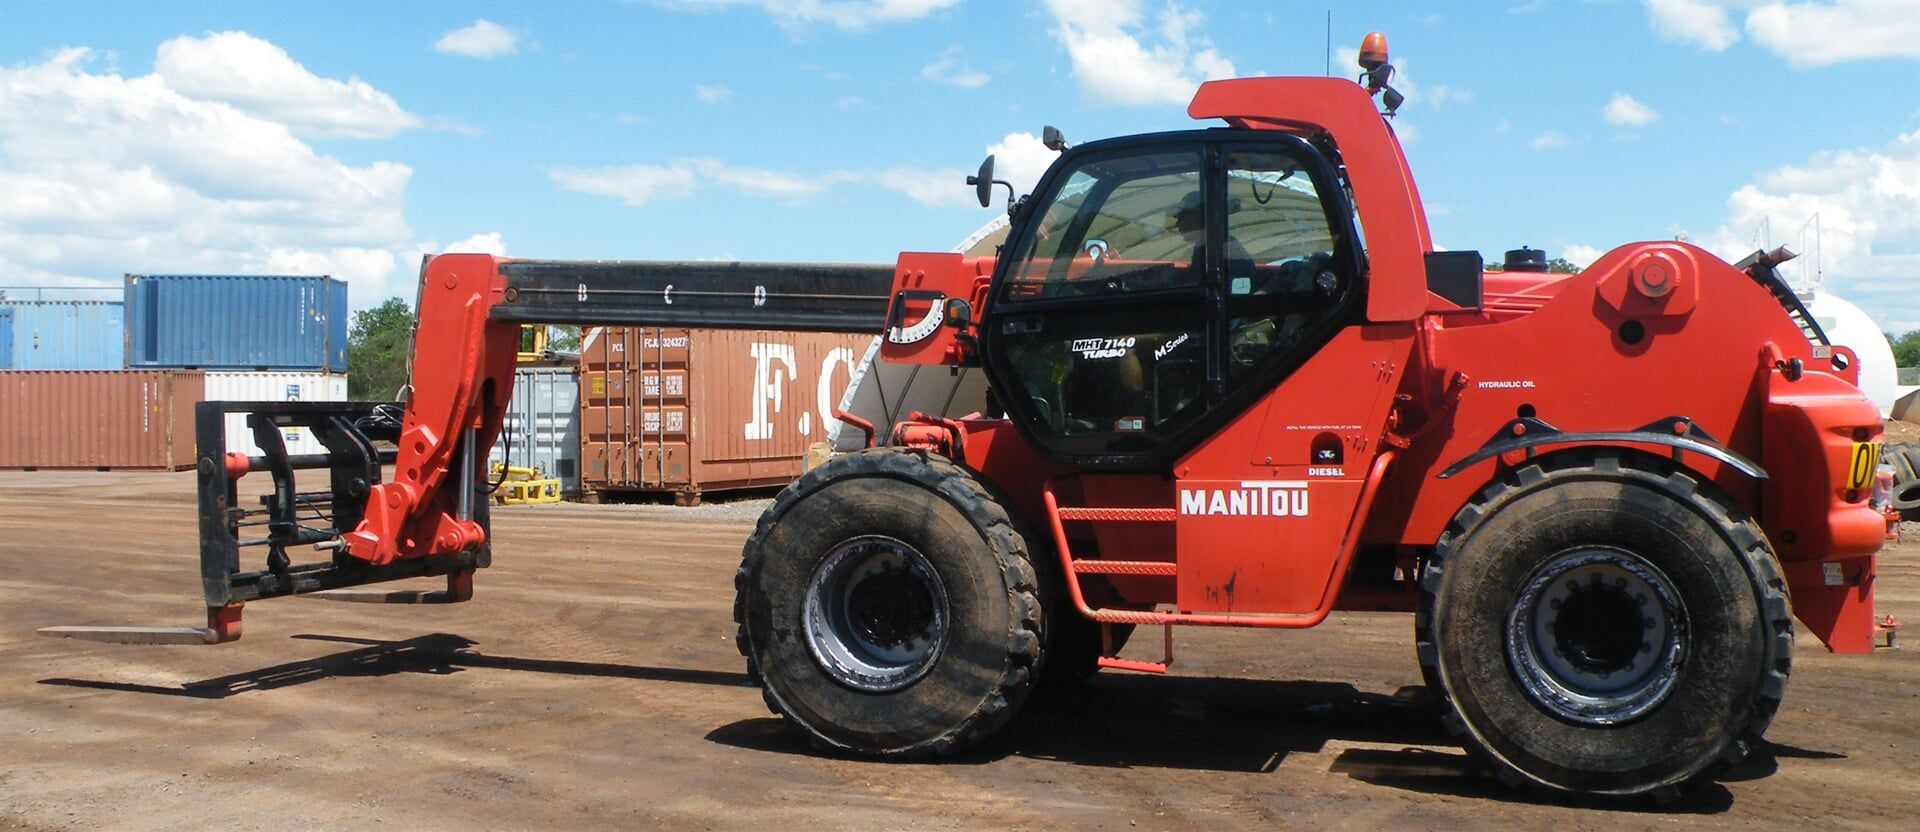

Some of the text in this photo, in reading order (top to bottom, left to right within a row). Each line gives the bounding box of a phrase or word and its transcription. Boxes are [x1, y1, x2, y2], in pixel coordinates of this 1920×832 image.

[664, 284, 674, 305] C
[1072, 337, 1136, 352] MHT 7140
[1083, 349, 1127, 360] TURBO
[1478, 380, 1536, 389] HYDRAULIC OIL
[644, 386, 660, 396] TARE
[1308, 467, 1346, 477] DIESEL
[1180, 481, 1309, 517] MANITOU
